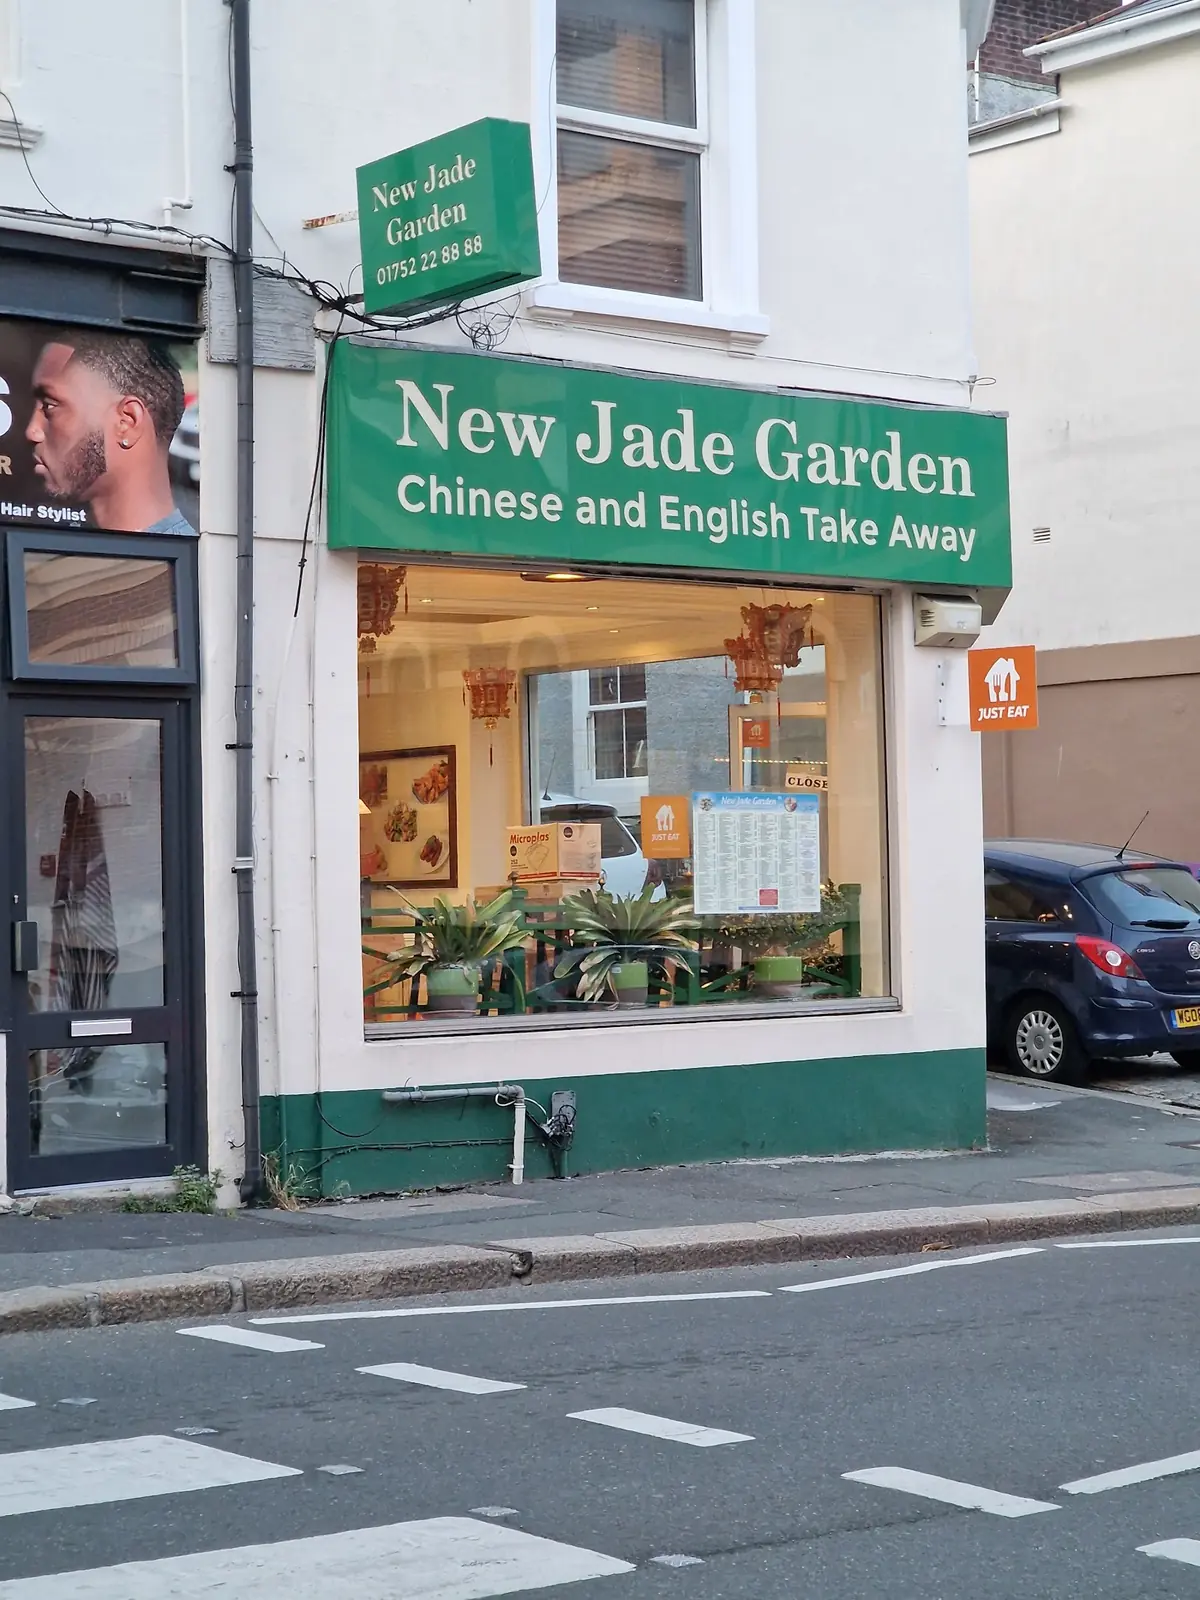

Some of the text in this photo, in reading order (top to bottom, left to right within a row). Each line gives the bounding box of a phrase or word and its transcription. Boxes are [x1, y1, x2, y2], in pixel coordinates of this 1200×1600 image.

[372, 154, 477, 212] New Jade
[386, 203, 467, 245] Garden
[377, 235, 483, 285] 01752 22 88 88
[395, 379, 976, 497] New Jade Garden
[0, 502, 87, 523] Hair Stylist
[397, 474, 977, 562] Chinese and English Take Away
[977, 705, 1030, 721] JUST EAT
[509, 832, 550, 844] Microplas
[651, 833, 680, 842] JUST EAT
